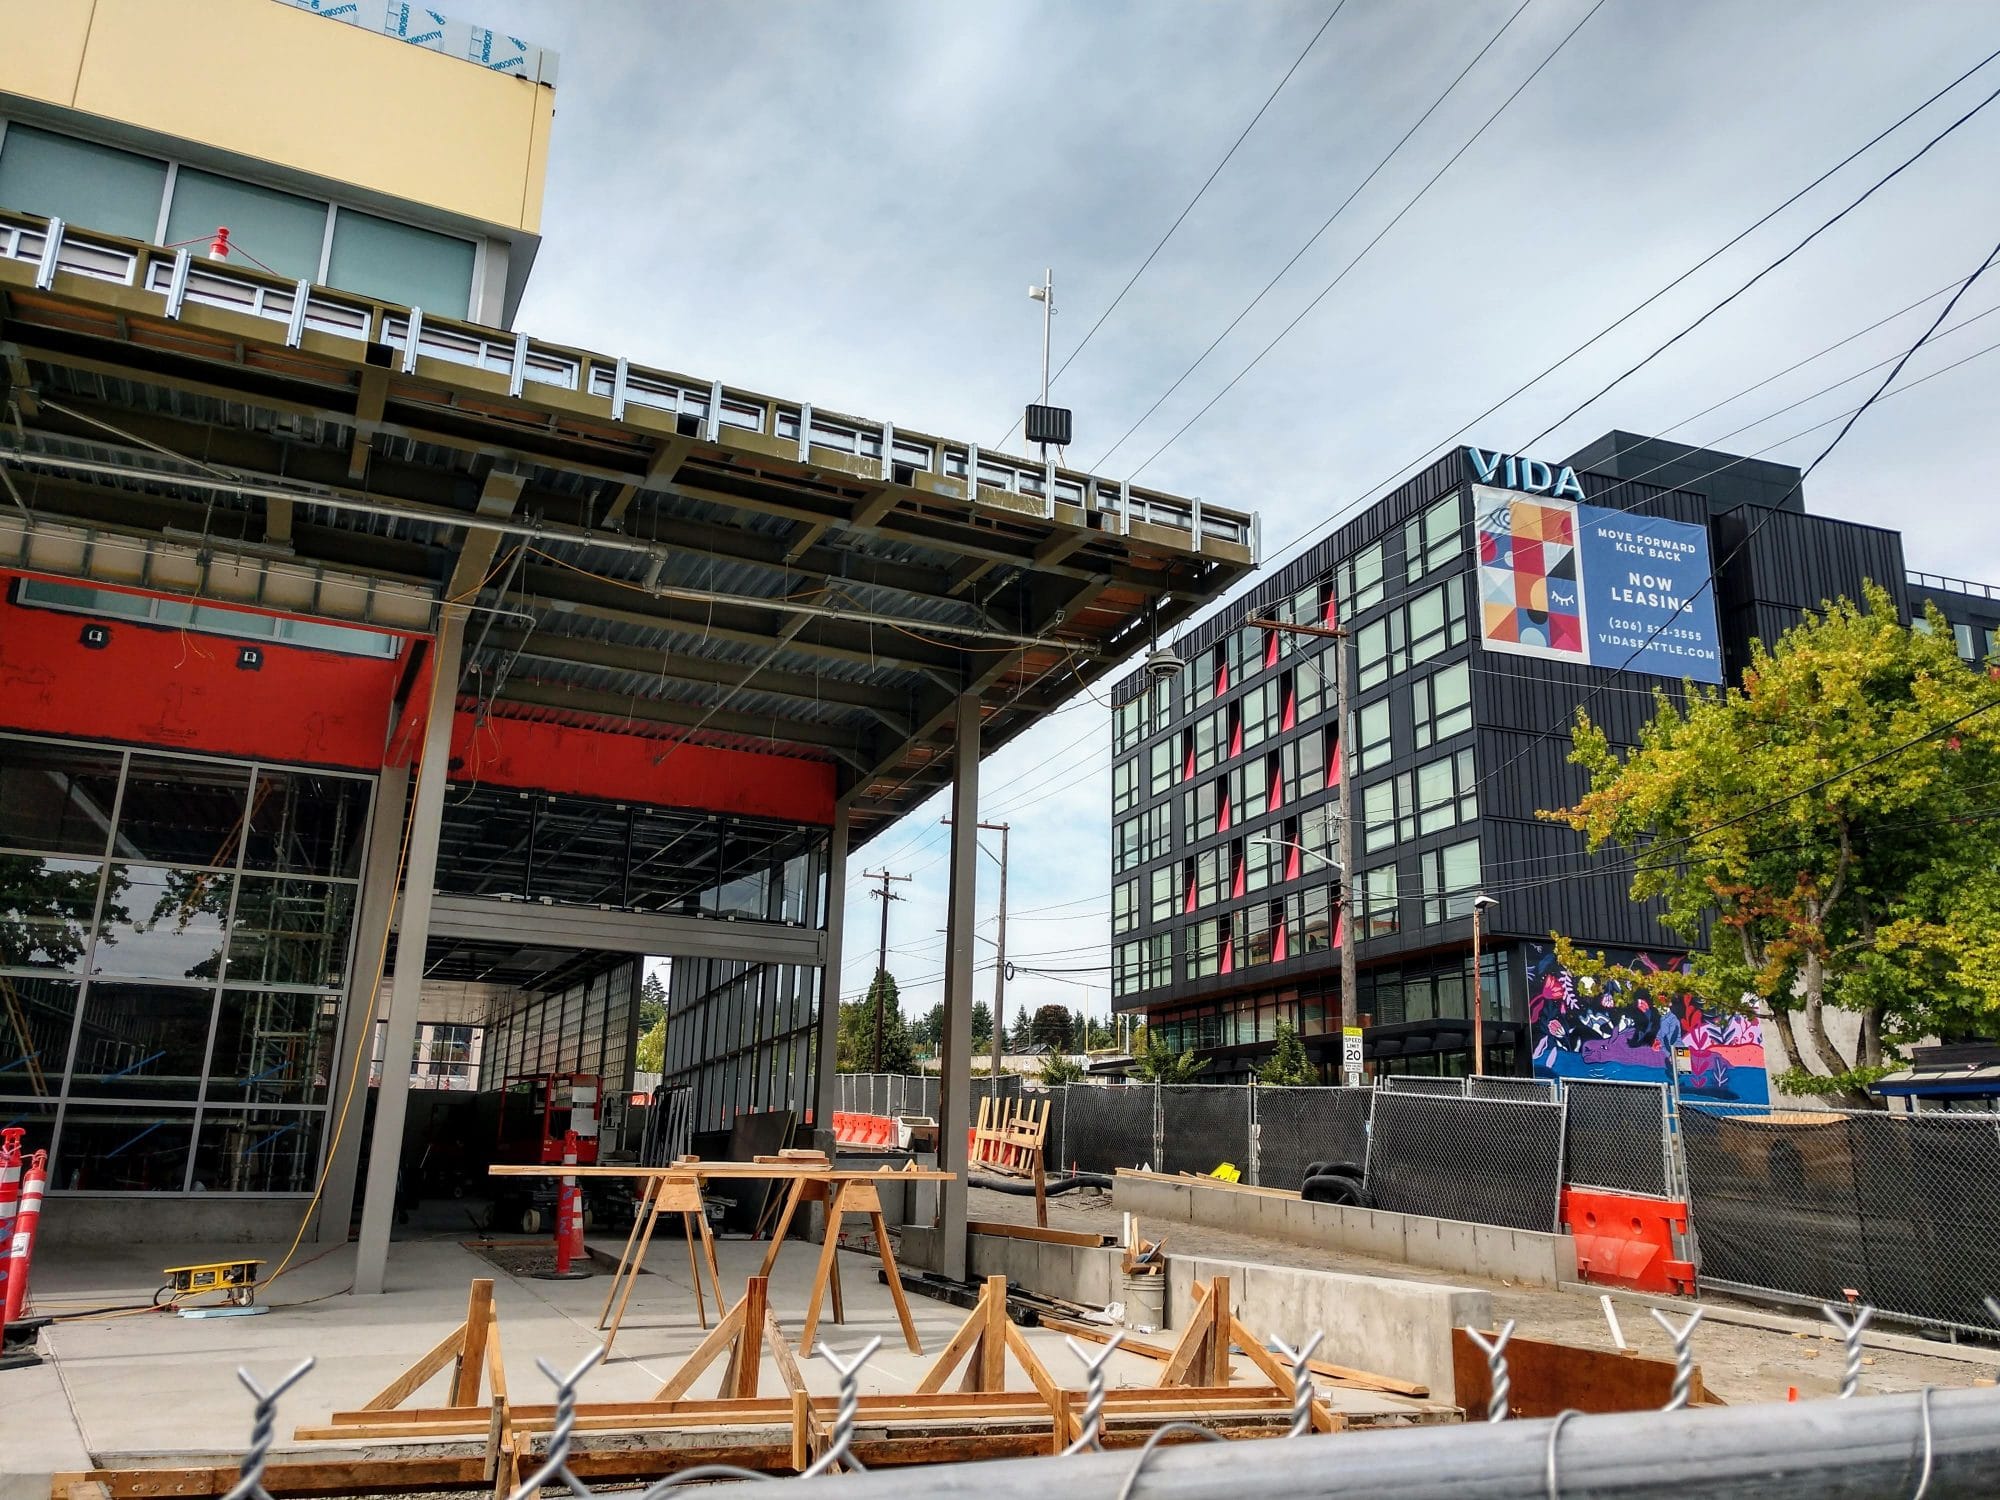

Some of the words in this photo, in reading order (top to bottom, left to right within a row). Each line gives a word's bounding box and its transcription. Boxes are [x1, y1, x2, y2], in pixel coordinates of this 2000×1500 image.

[1468, 447, 1586, 502] VIDA
[1598, 528, 1633, 542] MOVE
[1637, 535, 1696, 554] FORWARD
[1616, 542, 1645, 556] KICK
[1649, 548, 1681, 562] BACK
[1628, 572, 1673, 592] NOW
[1611, 587, 1694, 613] LEASING
[1609, 616, 1642, 633] (206)
[1598, 633, 1715, 660] VIDASEATTLE.COM
[1346, 1049, 1361, 1061] 20
